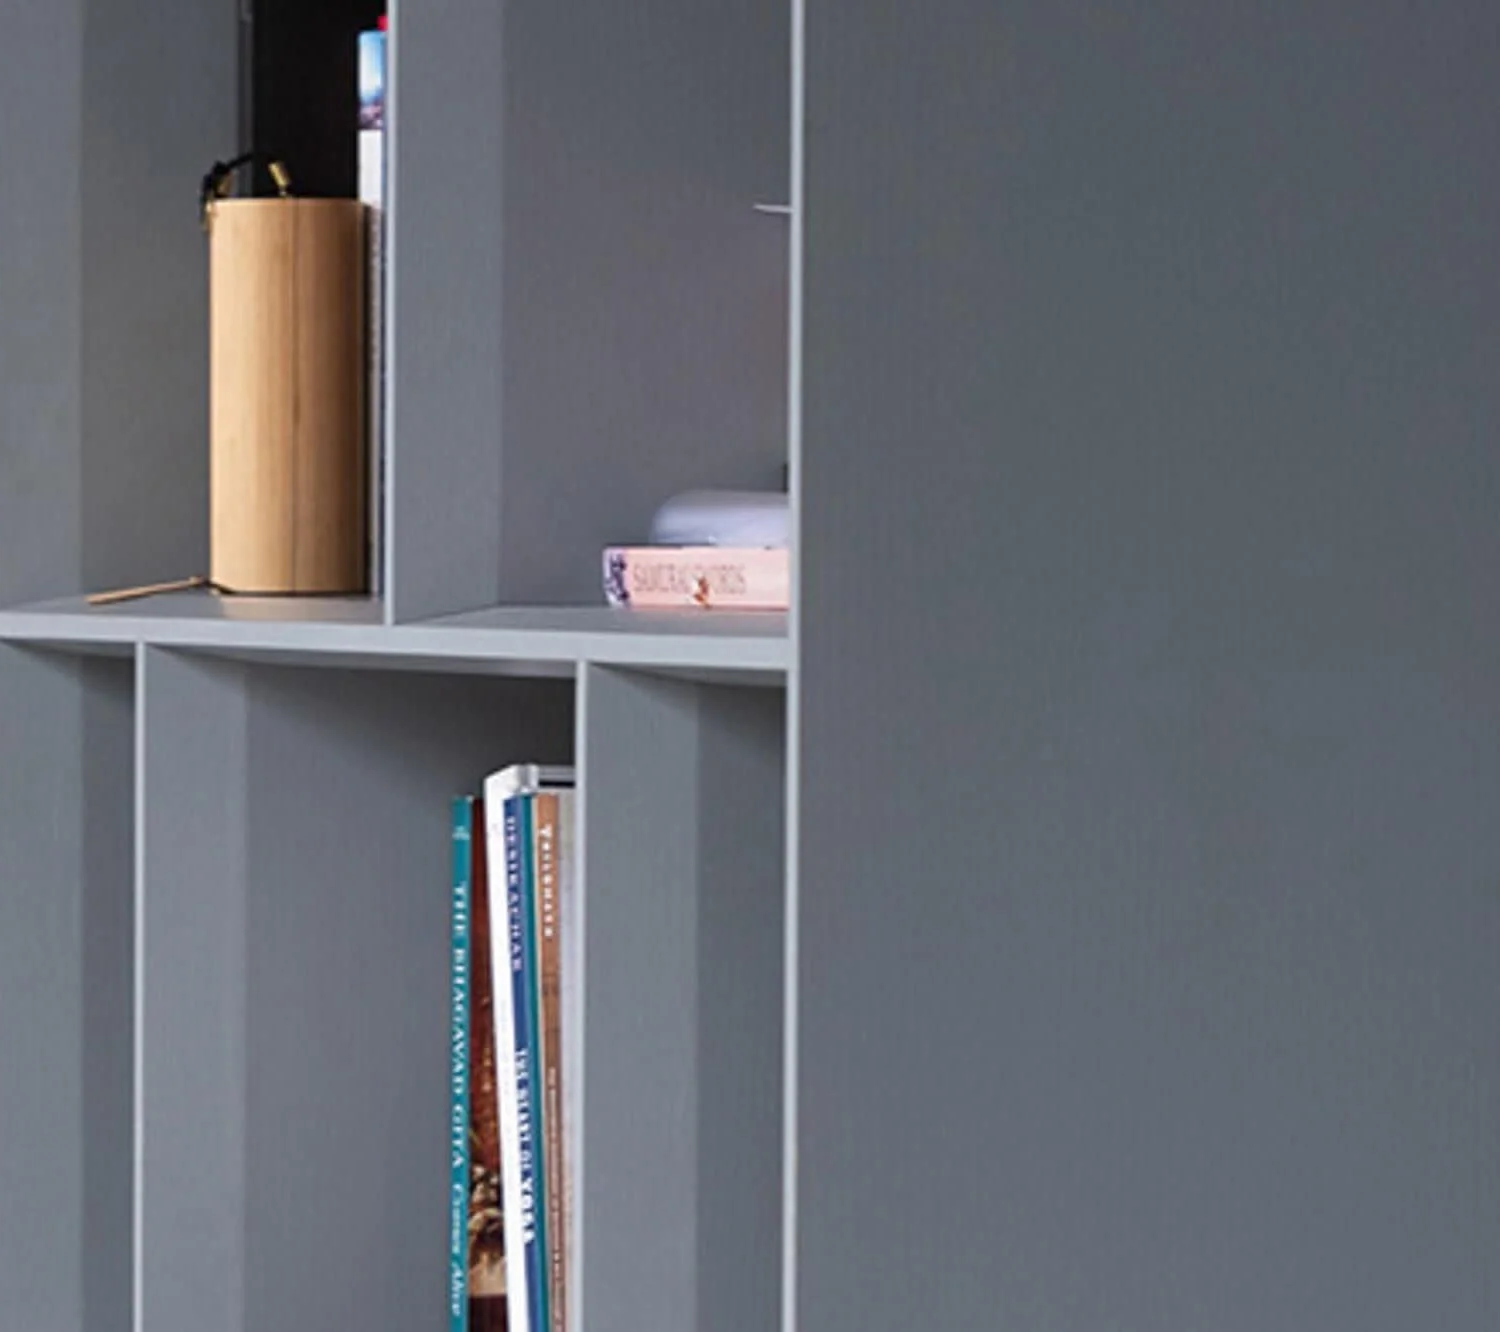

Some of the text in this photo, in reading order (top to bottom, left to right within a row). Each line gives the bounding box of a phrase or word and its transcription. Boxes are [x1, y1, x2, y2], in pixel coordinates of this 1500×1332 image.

[453, 881, 466, 938] THE
[452, 947, 466, 1095] BHAGAVAD
[451, 1104, 465, 1168] GITA
